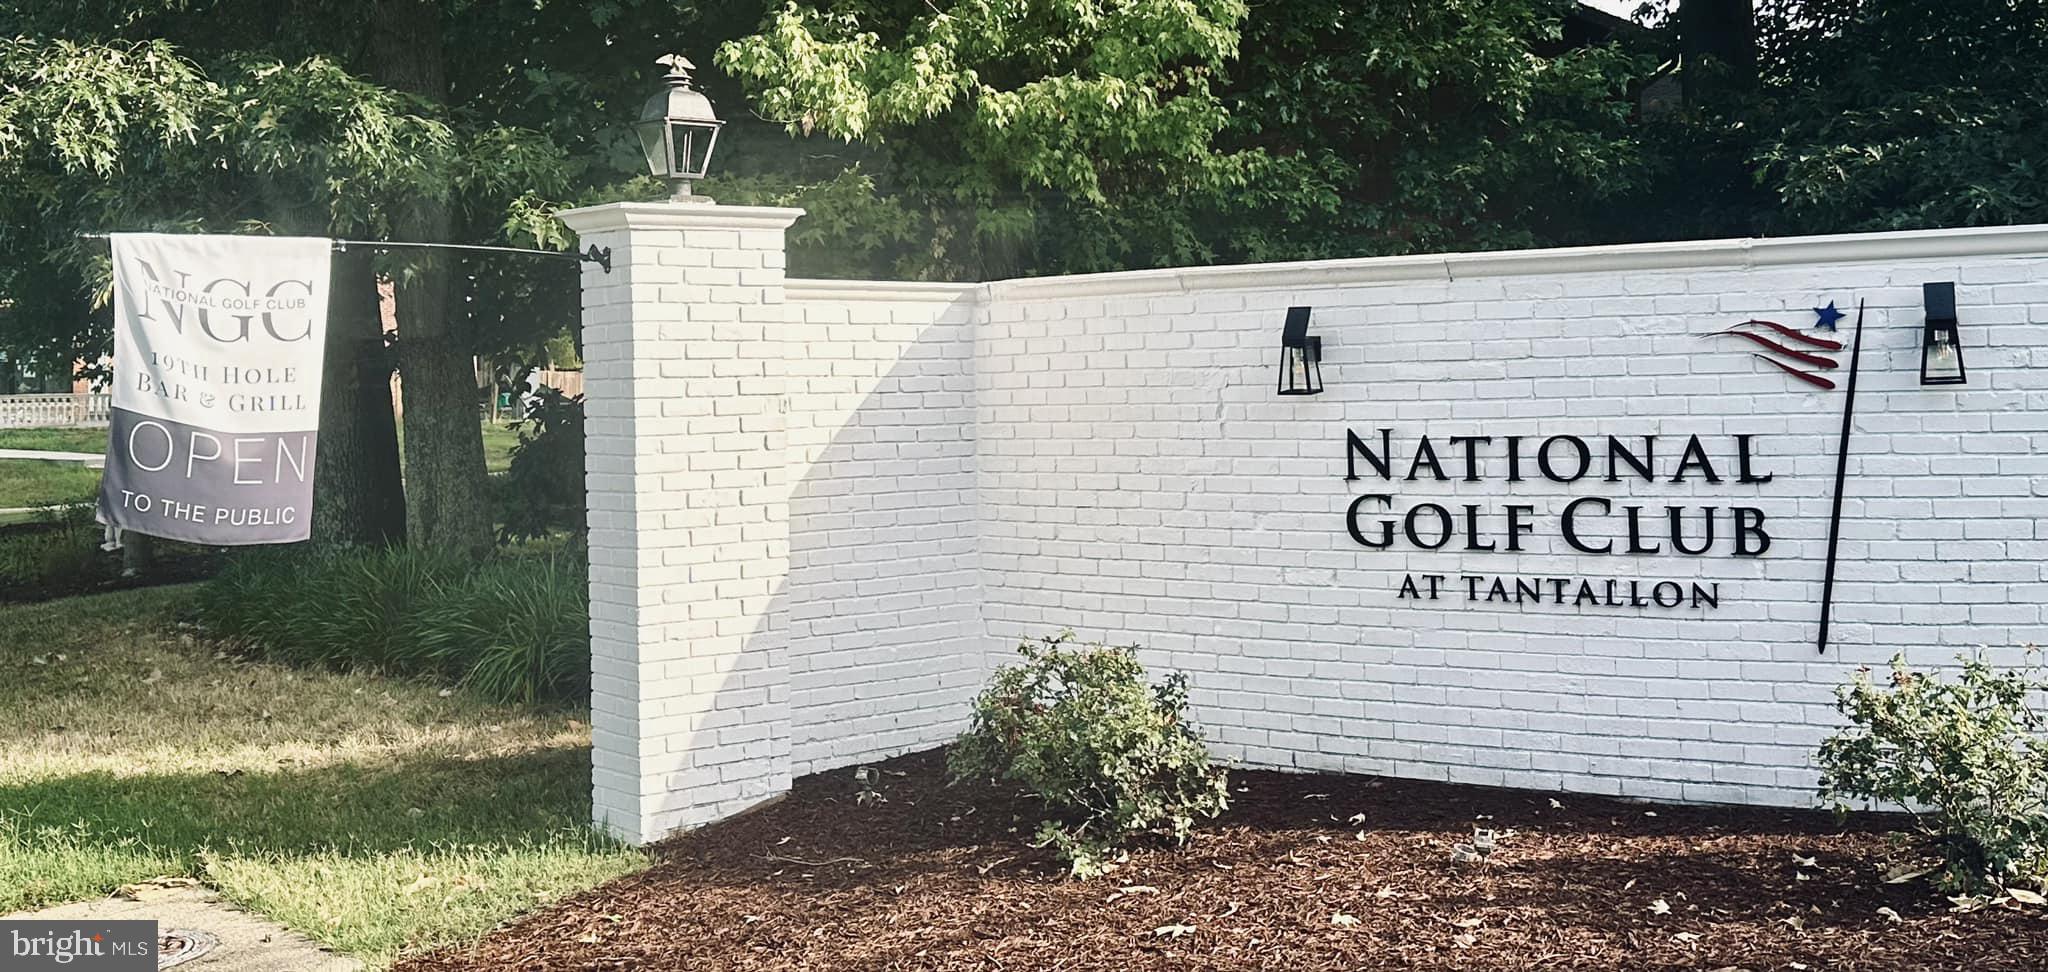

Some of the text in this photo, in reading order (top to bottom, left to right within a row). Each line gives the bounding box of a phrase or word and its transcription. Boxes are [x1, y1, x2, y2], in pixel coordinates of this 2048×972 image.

[135, 257, 313, 343] NGC
[222, 298, 260, 310] GOLF
[266, 298, 306, 310] CLUB
[151, 351, 296, 385] 19TH HOLE
[137, 372, 306, 413] BAR & GRILL
[129, 420, 307, 485] OPEN
[1343, 428, 1773, 484] NATIONAL
[121, 489, 296, 526] TO THE PUBLIC
[1346, 493, 1771, 556] GOLF CLUB
[1398, 573, 1720, 609] AT TANTALLON
